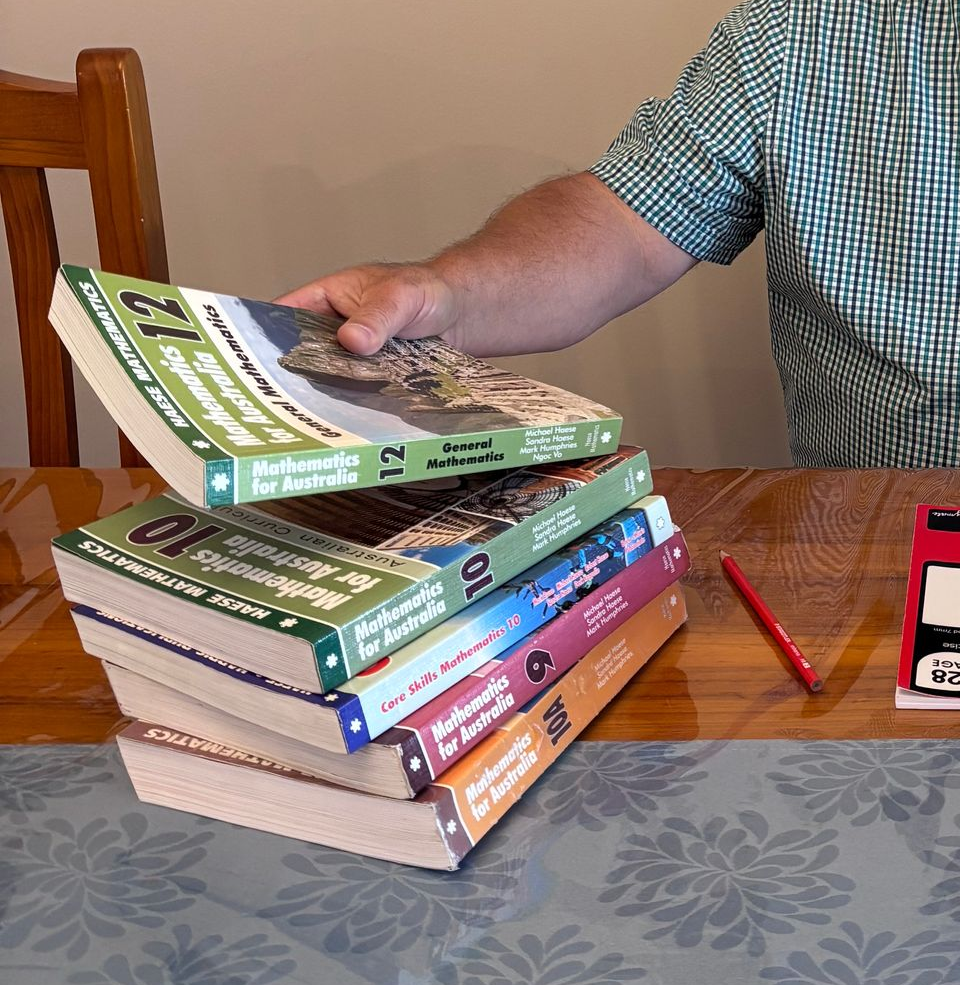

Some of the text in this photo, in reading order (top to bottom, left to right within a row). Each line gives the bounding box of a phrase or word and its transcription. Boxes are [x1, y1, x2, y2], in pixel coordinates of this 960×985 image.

[117, 289, 205, 345] 12
[79, 280, 190, 429] HAESE MATHEMATICS
[202, 304, 342, 439] General Mathematics
[160, 344, 267, 447] Mathematics
[192, 351, 303, 444] for Australia
[442, 438, 493, 454] General
[519, 442, 577, 455] Mark Humphries
[525, 426, 577, 438] Michael Haese
[525, 434, 575, 446] Sandra Haese
[252, 451, 360, 477] Mathematics
[378, 444, 407, 482] 12
[426, 451, 505, 470] Mathematics
[533, 451, 563, 462] Ngoc Vo
[252, 469, 358, 496] for Australia
[126, 512, 228, 560] 10
[532, 505, 576, 534] Michael Haese
[532, 519, 581, 553] Mark Humphries
[534, 514, 577, 542] Sandra Haese
[222, 534, 382, 595] for Australia
[299, 533, 407, 569] Australian
[77, 540, 273, 620] HAESE MATHEMATICS
[188, 549, 354, 611] Mathematics
[460, 551, 495, 603] 10
[354, 581, 444, 643] Mathematics
[583, 587, 621, 620] Michael Haese
[586, 601, 629, 637] Mark Humphries
[587, 595, 623, 627] Sandra Haese
[358, 600, 446, 662] for Australia
[380, 614, 522, 715] Core Skills Mathematics 10
[431, 675, 510, 743] Mathematics
[438, 692, 515, 761] for Australia
[542, 694, 573, 747] 10A
[144, 728, 293, 772] THEMATICS
[465, 732, 532, 805] Mathematics
[470, 750, 538, 822] for Australia
